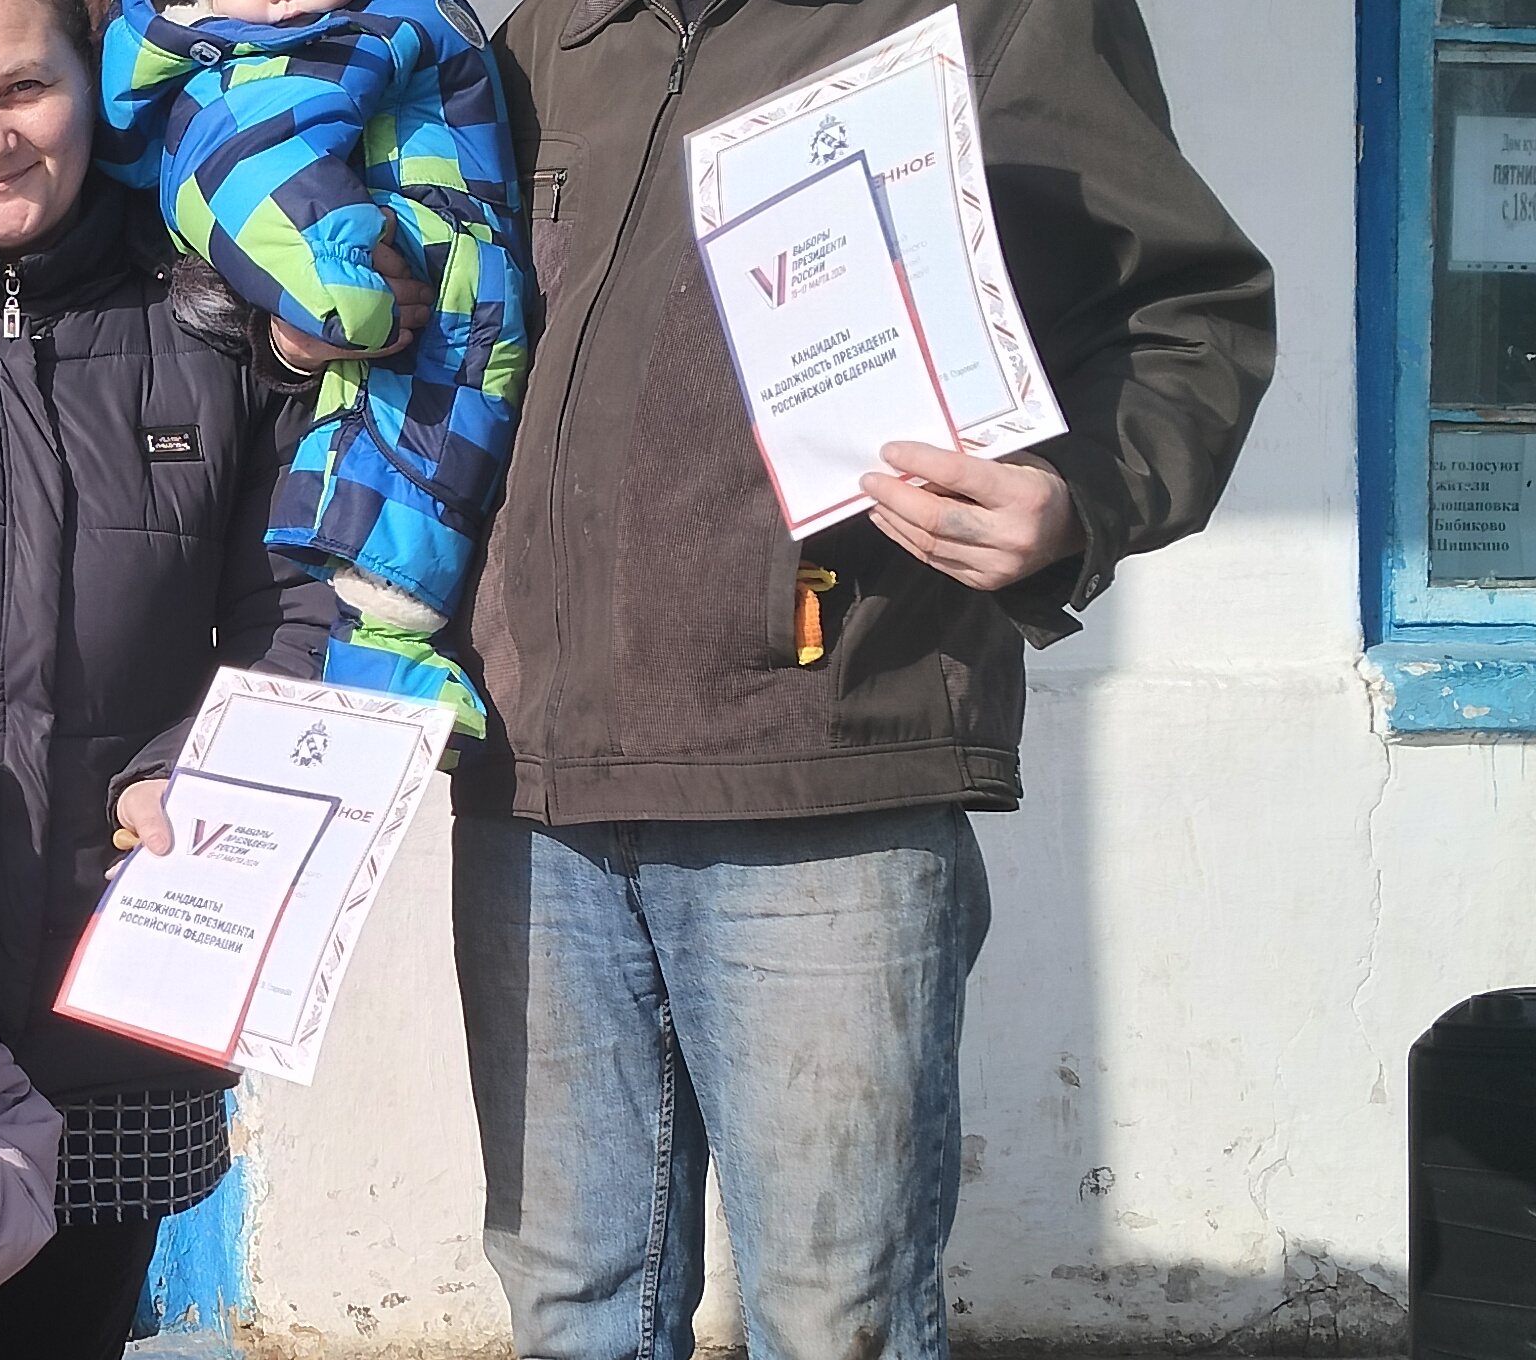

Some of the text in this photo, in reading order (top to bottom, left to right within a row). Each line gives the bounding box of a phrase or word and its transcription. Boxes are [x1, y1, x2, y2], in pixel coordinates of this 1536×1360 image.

[1523, 139, 1536, 157] ку
[792, 228, 830, 256] ВЫБОРЫ
[792, 235, 847, 272] ПРЕЗИДЕНТА
[791, 260, 825, 287] РОССИИ
[760, 327, 899, 402] НА ДОЛЖНОСТЬ ПРЕЗИДЕНТА
[791, 328, 851, 367] КАНДИДАТЫ
[771, 376, 833, 417] РОССИЙСКОЙ
[834, 348, 897, 387] ФЕДЕРАЦИИ
[1451, 461, 1521, 475] голосуют
[120, 895, 255, 939] НА ДОЛЖНОСТЬ ПРЕЗИДЕНТА
[164, 890, 223, 913] КАНДИДАТЫ
[119, 911, 243, 953] РОССИЙСКОЙ ФЕДЕРАЦИИ
